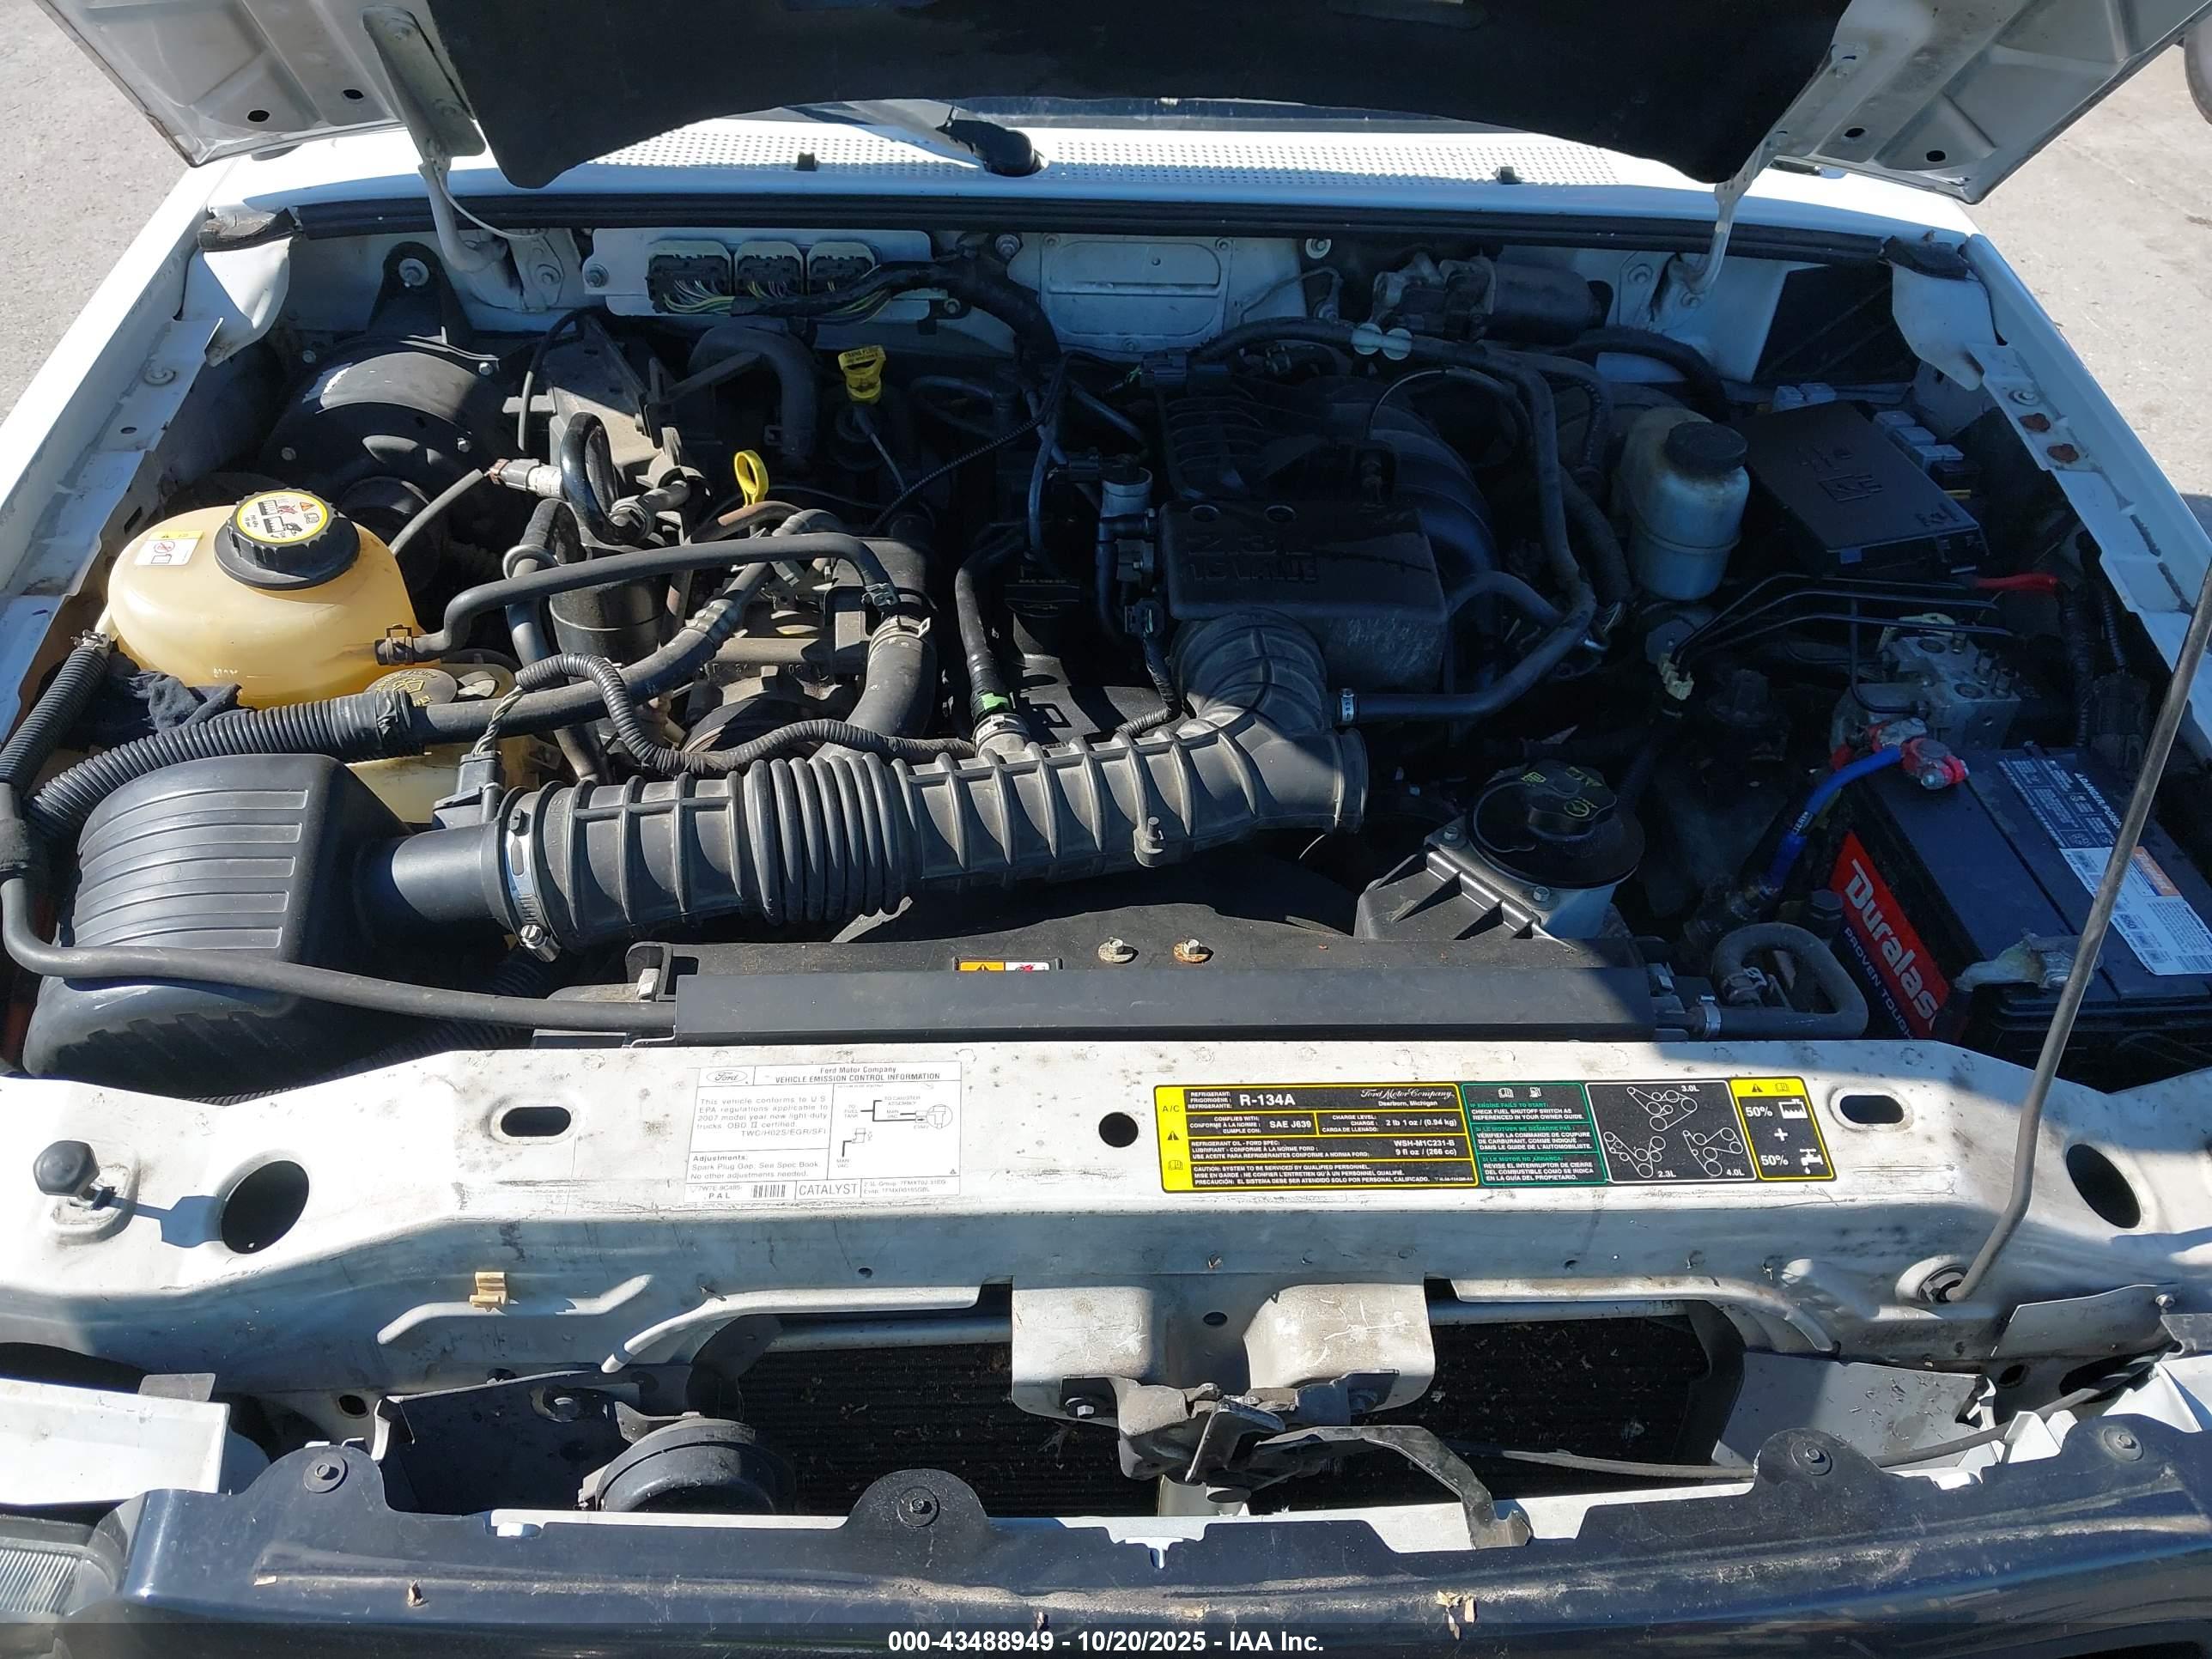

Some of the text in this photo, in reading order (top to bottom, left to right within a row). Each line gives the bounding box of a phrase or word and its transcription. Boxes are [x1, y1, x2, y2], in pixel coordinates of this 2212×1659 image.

[1844, 927, 1881, 987] PROVEN
[862, 1066, 896, 1074] Company
[887, 1073, 940, 1081] INFORMATION
[1360, 1087, 1455, 1100] Ford Motor Company
[1239, 1093, 1296, 1106] R-134A
[1745, 1106, 1772, 1118] 50%
[1444, 1119, 1457, 1128] kg)
[1760, 1155, 1789, 1166] 50%
[726, 1171, 774, 1180] adjustments
[799, 1183, 858, 1195] CATALYST
